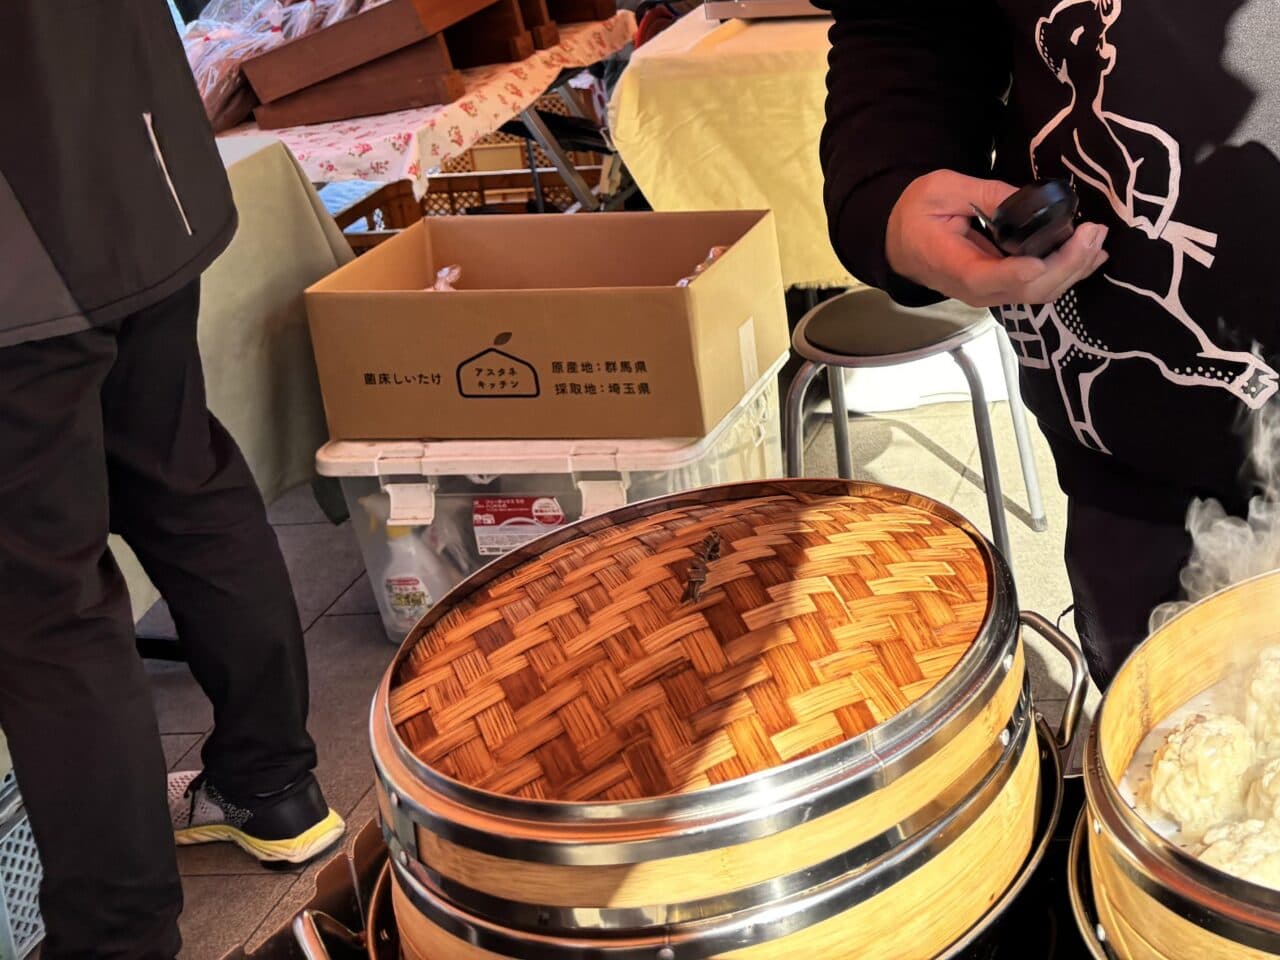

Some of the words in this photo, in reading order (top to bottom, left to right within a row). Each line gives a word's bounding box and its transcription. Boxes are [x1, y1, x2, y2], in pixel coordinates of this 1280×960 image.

[474, 367, 518, 378] アスタネ
[551, 360, 648, 374] 原産地：群馬県
[363, 372, 442, 386] 菌床しいたけ
[477, 380, 519, 389] キッチン
[554, 382, 651, 396] 採取地：埼玉県
